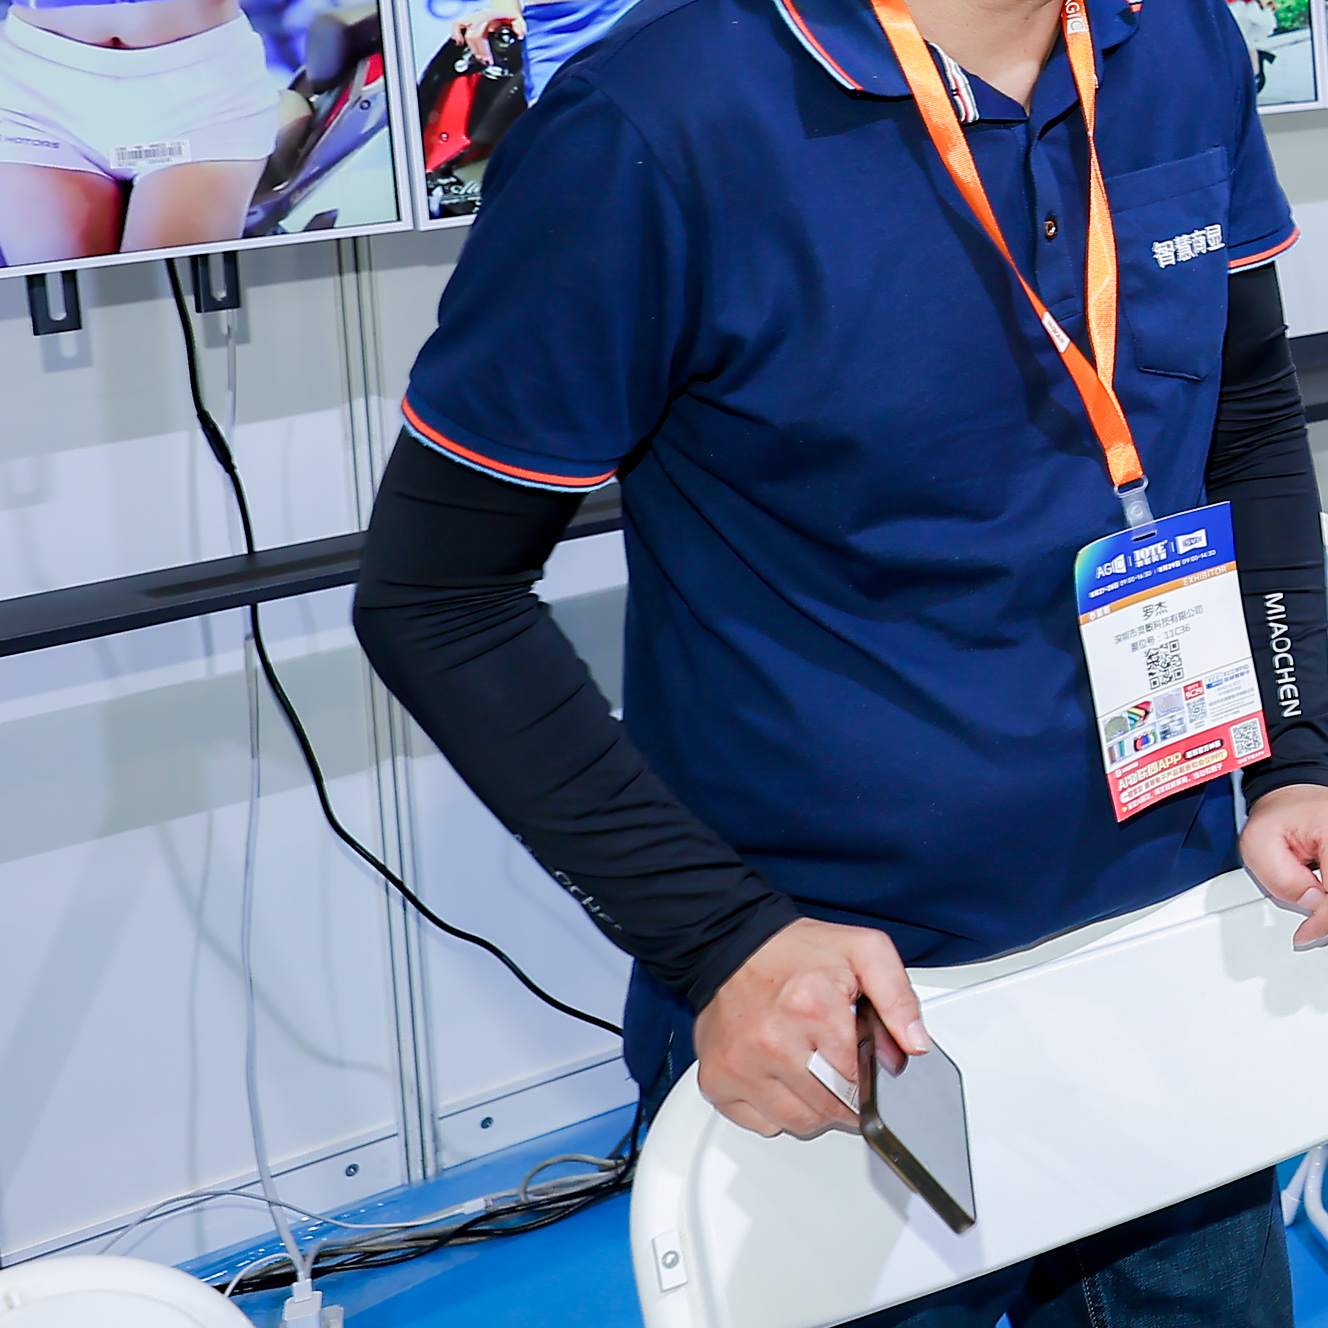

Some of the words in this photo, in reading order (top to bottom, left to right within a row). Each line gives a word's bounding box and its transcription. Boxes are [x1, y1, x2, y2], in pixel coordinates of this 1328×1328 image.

[1151, 223, 1226, 269] 智慧商显
[1183, 565, 1228, 586] EXHIBITOR
[1264, 592, 1302, 718] MIAOCHEN
